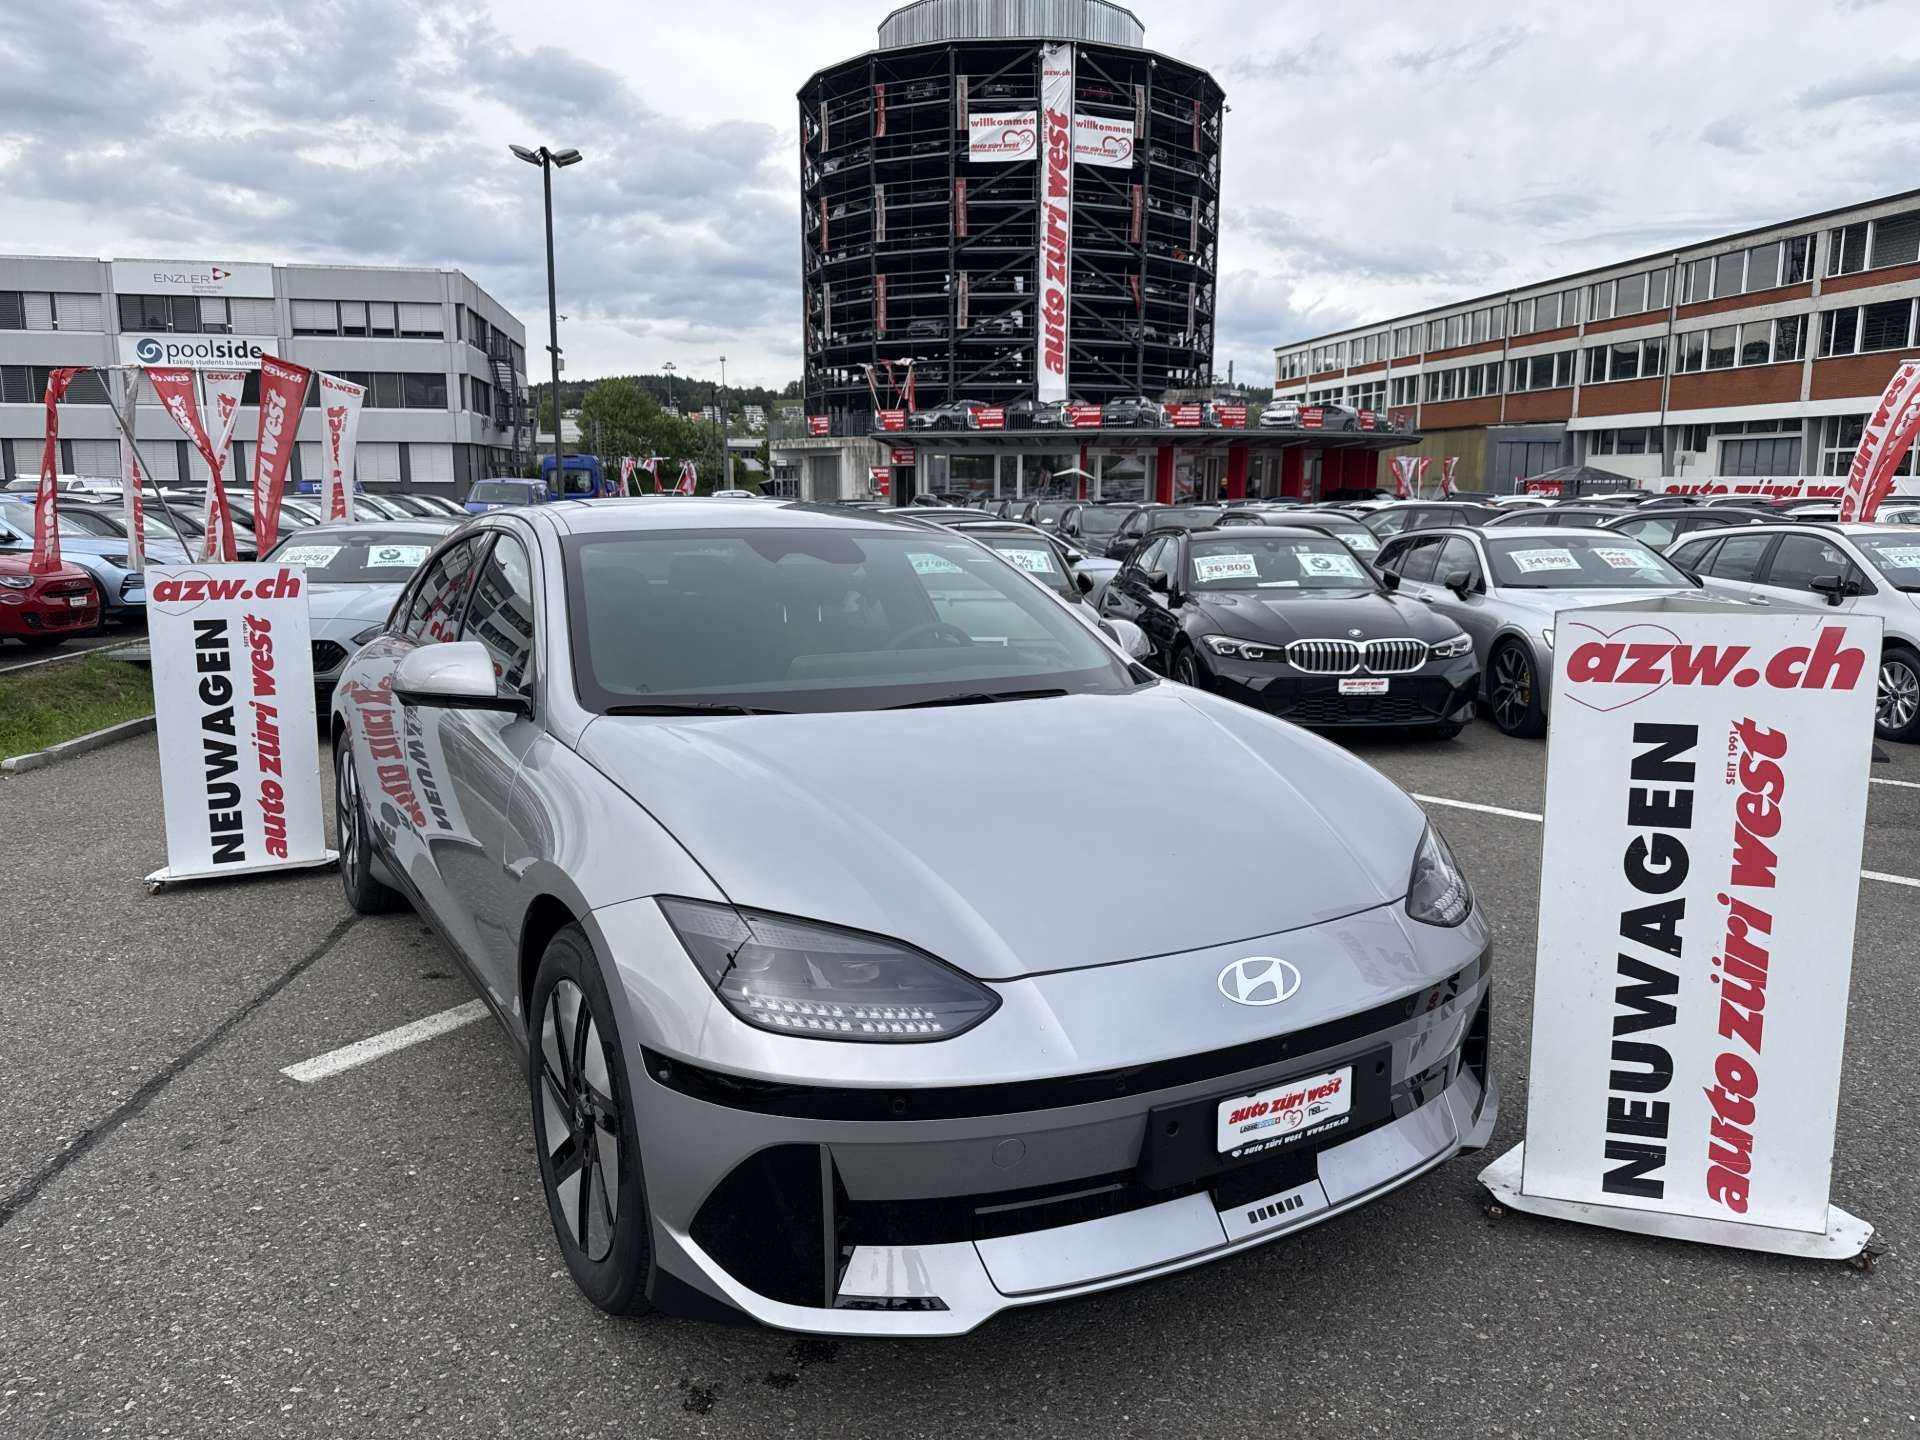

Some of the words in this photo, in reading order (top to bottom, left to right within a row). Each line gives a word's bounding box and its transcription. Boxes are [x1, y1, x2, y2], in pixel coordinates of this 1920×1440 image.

[1043, 69, 1071, 77] azw.ch
[970, 118, 1036, 128] willkommen
[1075, 119, 1133, 135] willkommen
[1046, 108, 1070, 197] west
[1042, 201, 1068, 287] züri
[153, 273, 210, 284] ENZLER
[166, 339, 262, 365] poolside
[1041, 288, 1066, 376] auto
[172, 359, 194, 367] taking
[262, 363, 304, 384] azw.ch
[260, 387, 287, 455] west
[152, 568, 301, 601] azw.ch
[1206, 563, 1251, 573] 36'800
[1525, 557, 1571, 566] 34'900
[243, 613, 276, 696] west
[1566, 626, 1867, 690] azw.ch
[193, 618, 246, 864] NEUWAGEN
[249, 700, 283, 778] züri
[1727, 730, 1739, 758] 1991
[1726, 761, 1737, 785] SEIT
[256, 779, 288, 859] auto
[1730, 716, 1788, 889] west
[1602, 722, 1699, 1200] NEUWAGEN
[1710, 892, 1772, 1056] züri
[1228, 1100, 1270, 1125] auto
[1270, 1088, 1307, 1114] züri
[1307, 1077, 1343, 1101] west
[1243, 1144, 1264, 1155] auto
[1264, 1138, 1283, 1150] züri
[1284, 1132, 1303, 1144] west
[1306, 1116, 1350, 1137] www.azw.ch
[1702, 1051, 1760, 1215] auto
